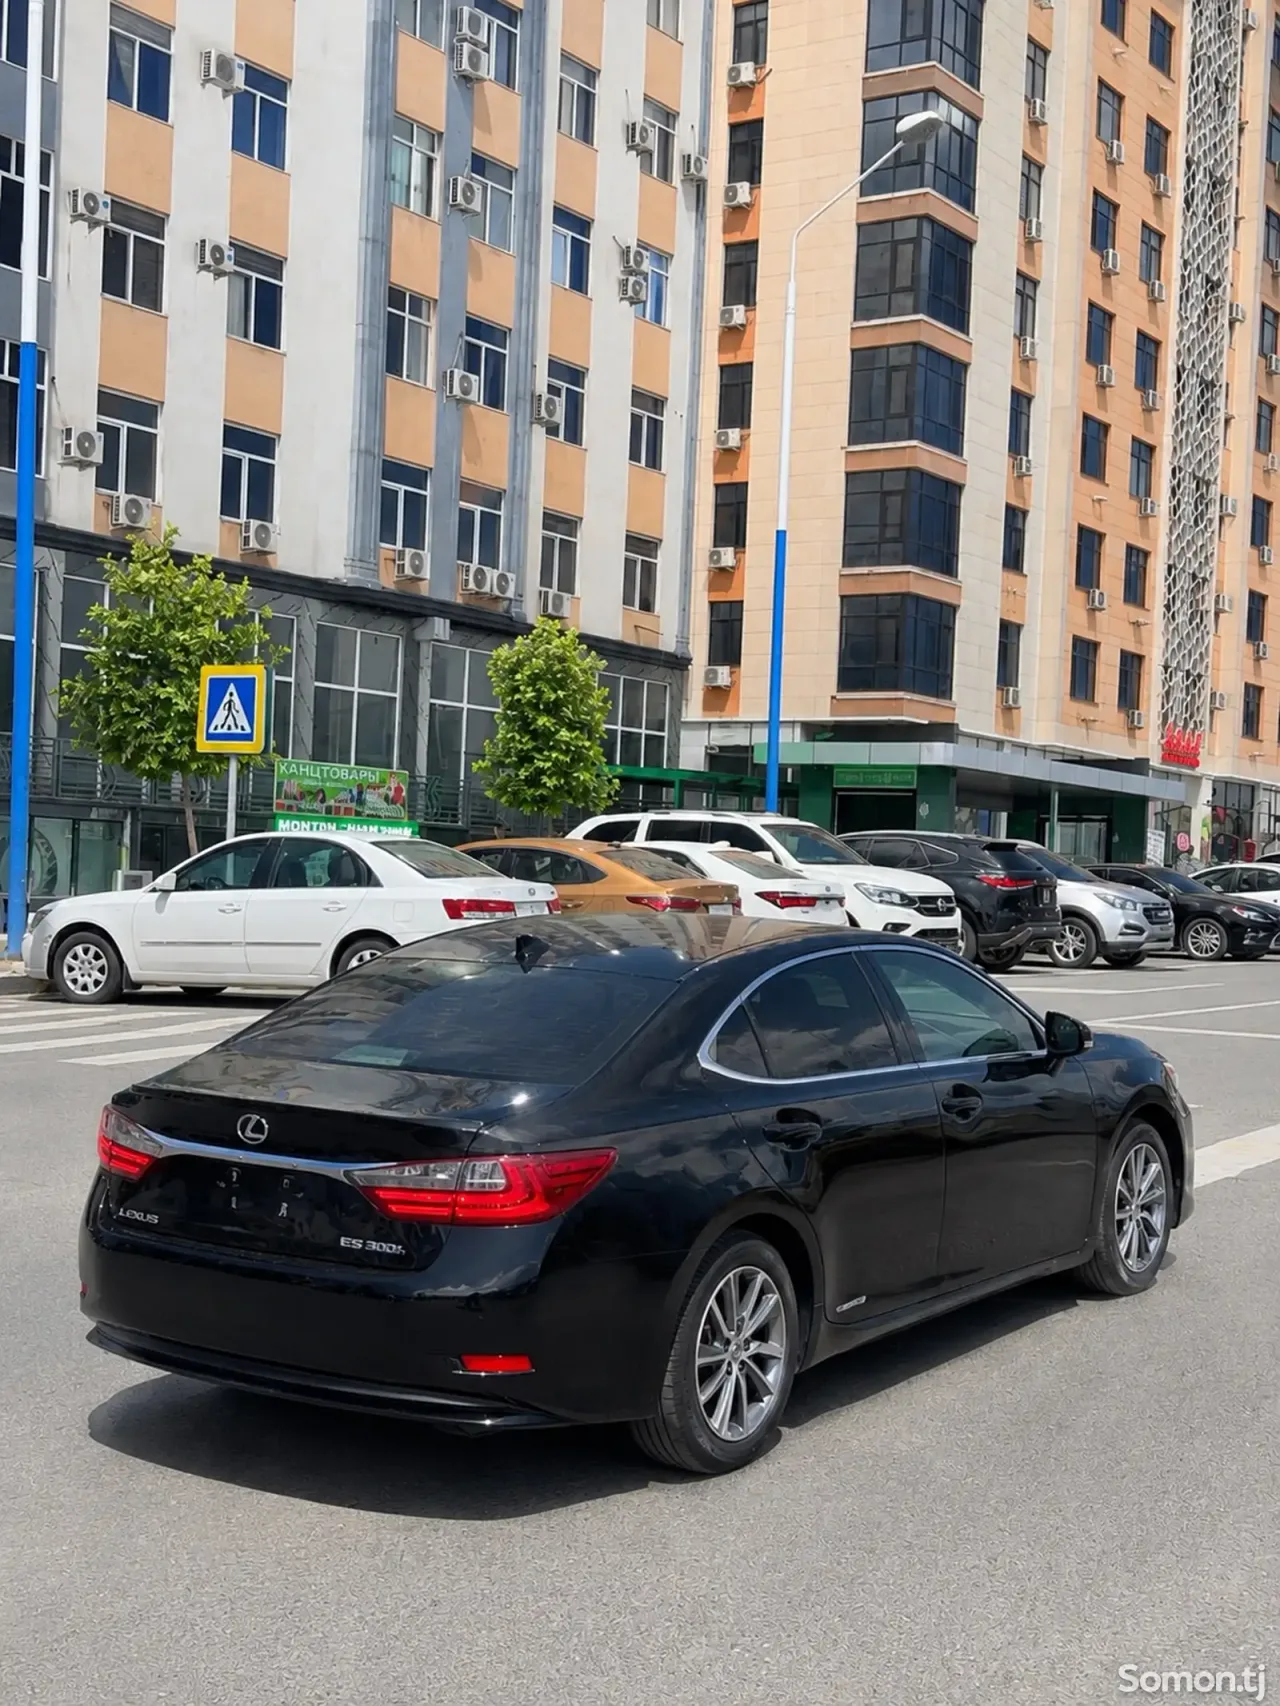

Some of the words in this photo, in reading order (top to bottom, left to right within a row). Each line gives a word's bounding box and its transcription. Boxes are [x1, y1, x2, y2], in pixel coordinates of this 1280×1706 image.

[278, 762, 380, 783] КАНЦТОВАРЫ
[118, 1207, 159, 1224] LEXUS
[340, 1236, 364, 1250] ES
